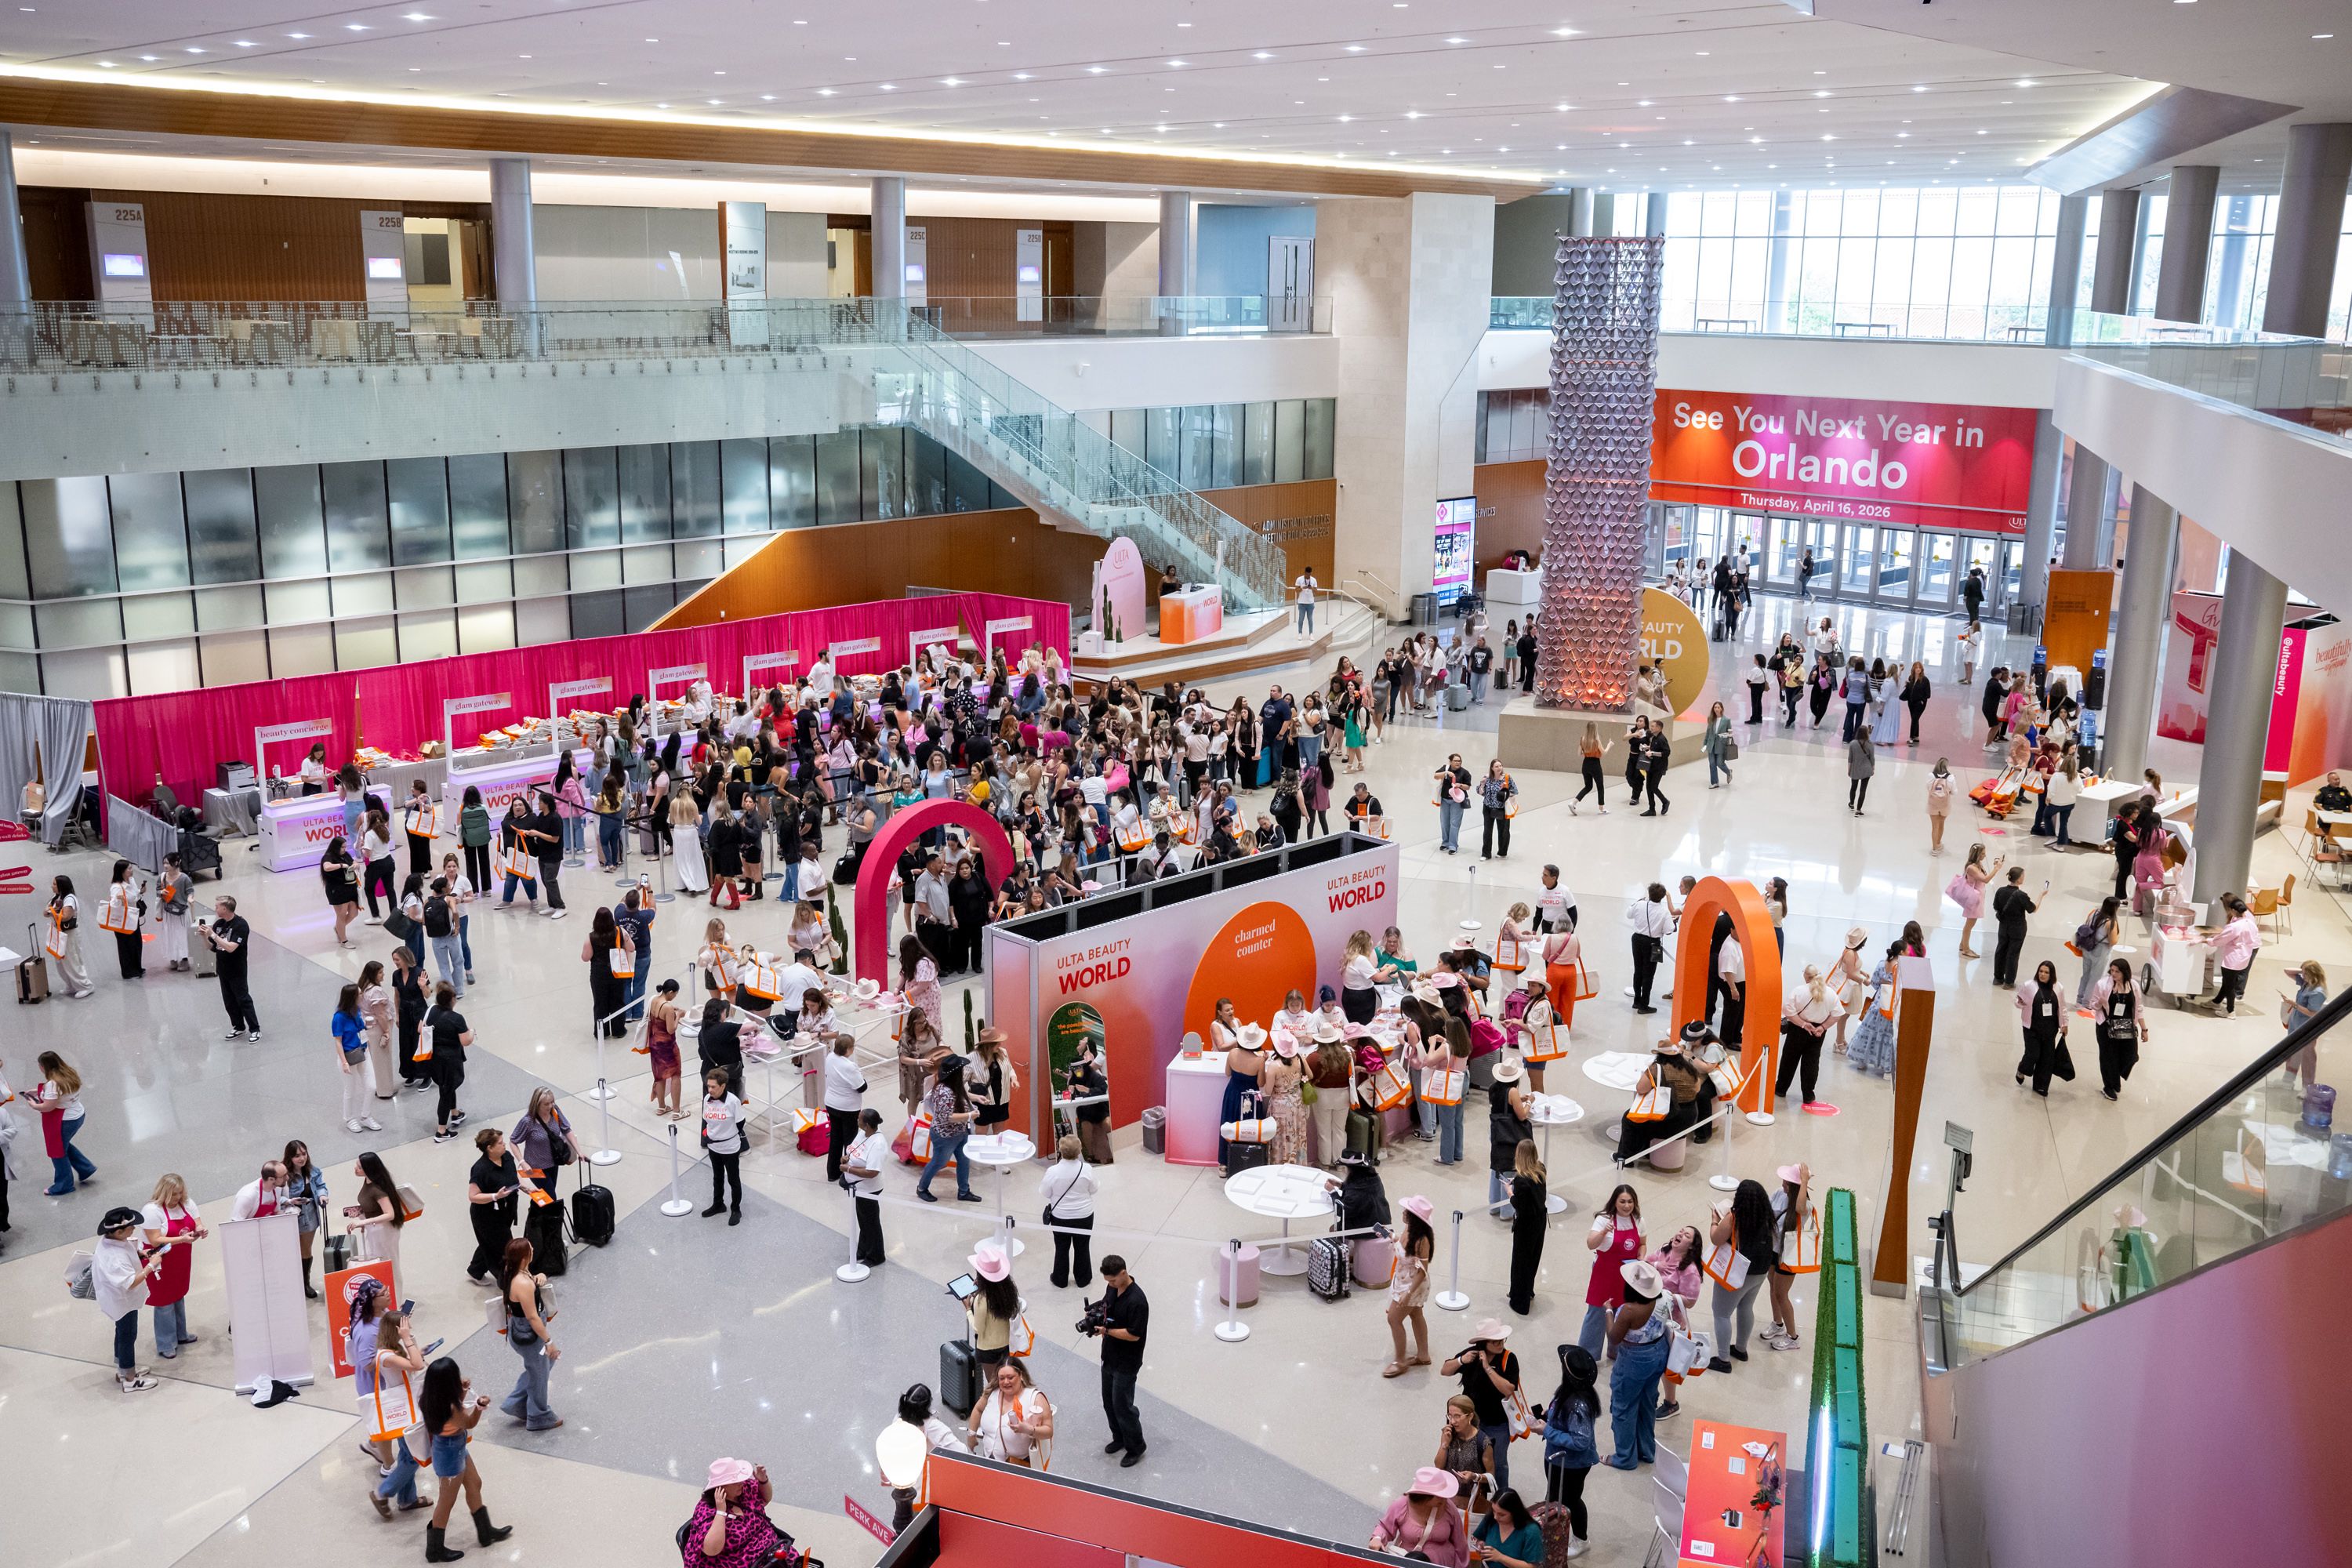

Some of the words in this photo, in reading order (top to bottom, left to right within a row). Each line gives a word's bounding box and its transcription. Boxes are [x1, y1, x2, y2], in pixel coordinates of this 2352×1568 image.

[115, 209, 143, 221] 225A
[379, 216, 401, 227] 225B
[910, 231, 925, 240] 225C
[1673, 402, 1724, 430] See
[1733, 405, 1784, 434] You
[1795, 409, 1867, 440] Next
[1877, 414, 1946, 445] Year
[1955, 418, 1984, 448] in
[1732, 440, 1907, 490] Orlando
[1740, 492, 1799, 511] Thursday,
[1803, 499, 1834, 513] April
[1838, 503, 1855, 516] 16,
[1858, 504, 1891, 517] 2026
[1262, 532, 1287, 543] MEETING
[1114, 549, 1130, 564] ULTA
[1203, 596, 1217, 608] WORLD
[931, 630, 952, 639] gateway
[1641, 622, 1685, 634] AUTY
[852, 641, 873, 651] gateway
[1639, 638, 1682, 659] RLD
[768, 655, 791, 664] gateway
[675, 669, 699, 677] gateway
[2274, 637, 2294, 696] @ultabeauty
[560, 686, 576, 695] glam
[577, 682, 603, 691] gateway
[474, 699, 503, 708] gateway
[260, 729, 289, 739] beauty
[289, 724, 328, 735] concierge
[485, 786, 503, 794] ULTA
[303, 818, 324, 827] ULTA
[306, 824, 349, 842] WORL
[1327, 875, 1348, 890] ULTA
[1352, 865, 1386, 883] BEAUTY
[1329, 881, 1385, 913] WORLD
[1235, 918, 1276, 944] charmed
[1057, 952, 1084, 970] ULTA
[1088, 938, 1131, 960] BEAUTY
[1236, 937, 1273, 958] counter
[1058, 956, 1131, 995] WORLD
[1381, 1083, 1395, 1094] WORLD
[386, 1410, 408, 1420] WORLD
[850, 1503, 870, 1528] PERK
[872, 1523, 889, 1543] AVE
